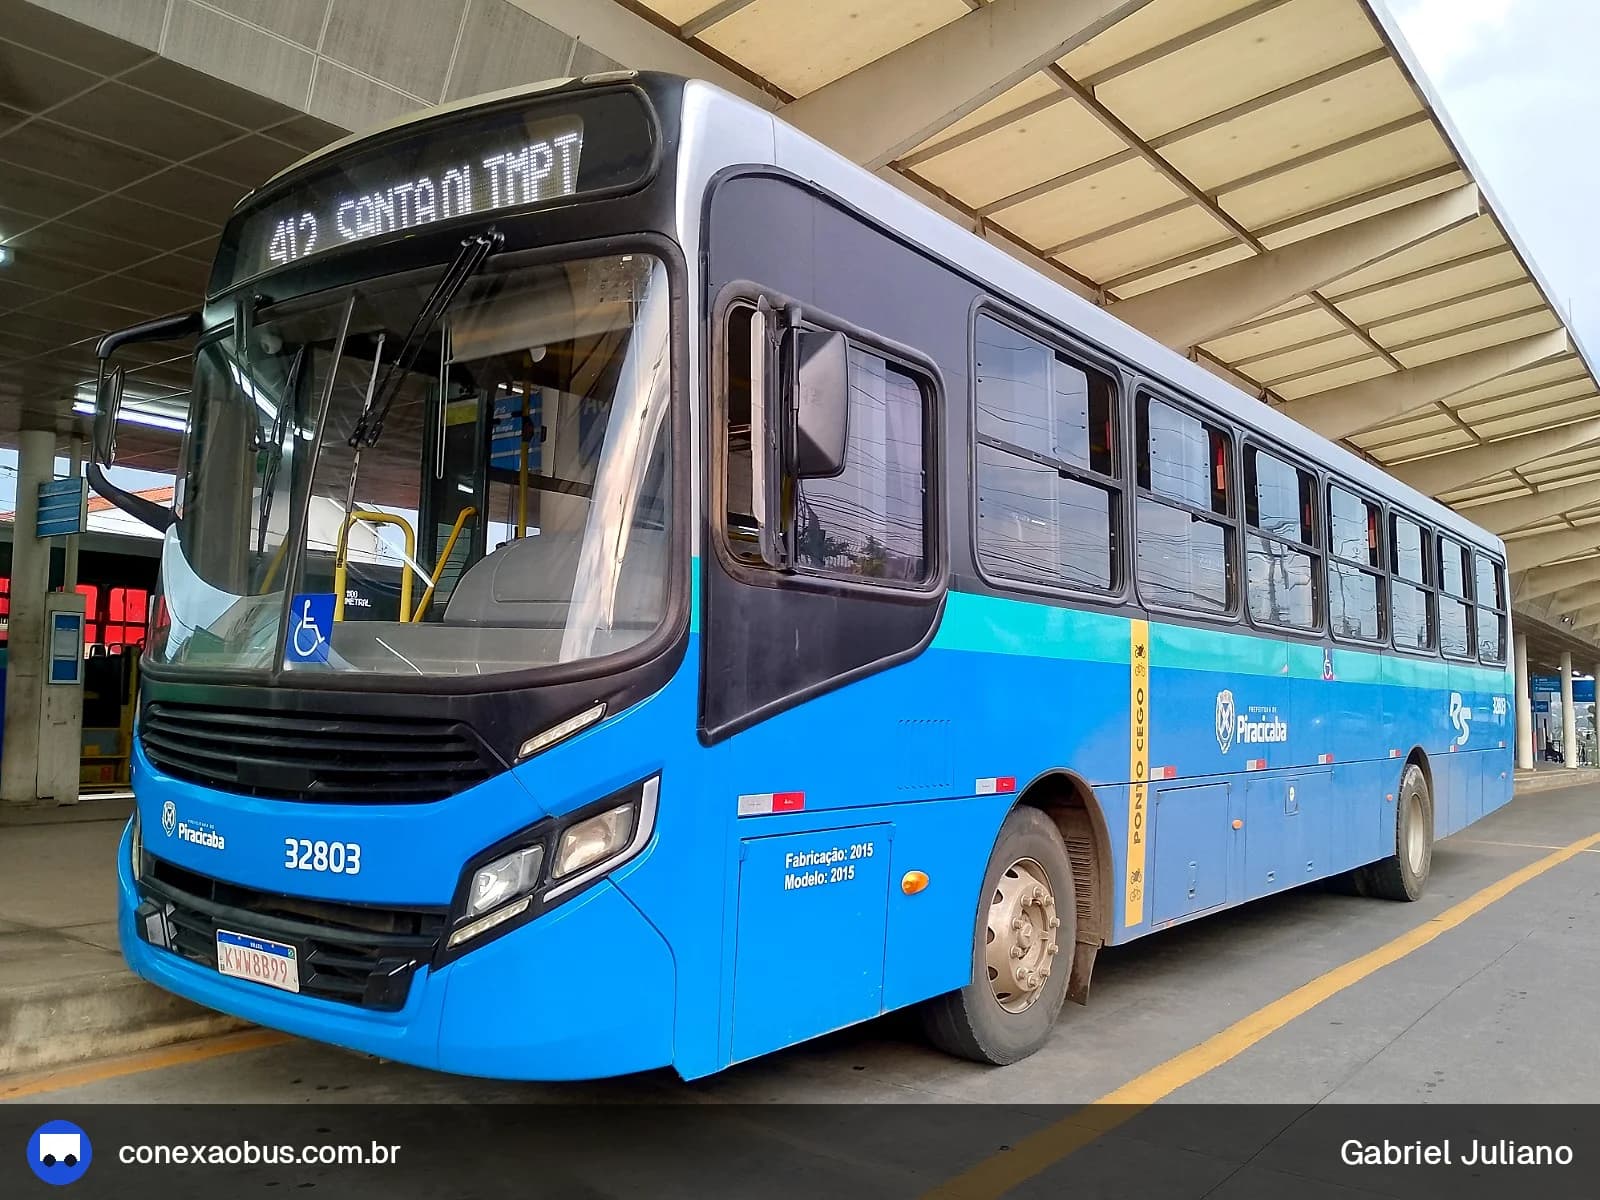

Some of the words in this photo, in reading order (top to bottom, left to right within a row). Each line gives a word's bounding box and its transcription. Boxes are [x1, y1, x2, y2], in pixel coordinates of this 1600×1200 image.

[269, 211, 317, 265] 412
[483, 132, 578, 208] TMPT
[1135, 686, 1145, 752] CEGO
[1236, 714, 1287, 743] Piracicaba
[1133, 759, 1145, 845] PONTO
[178, 822, 225, 850] Piracicaba
[284, 837, 361, 875] 32803
[785, 847, 848, 869] Fabricação:
[850, 842, 873, 860] 2015
[784, 869, 828, 891] Modelo:
[830, 865, 855, 883] 2015
[224, 946, 289, 984] KWW8B99
